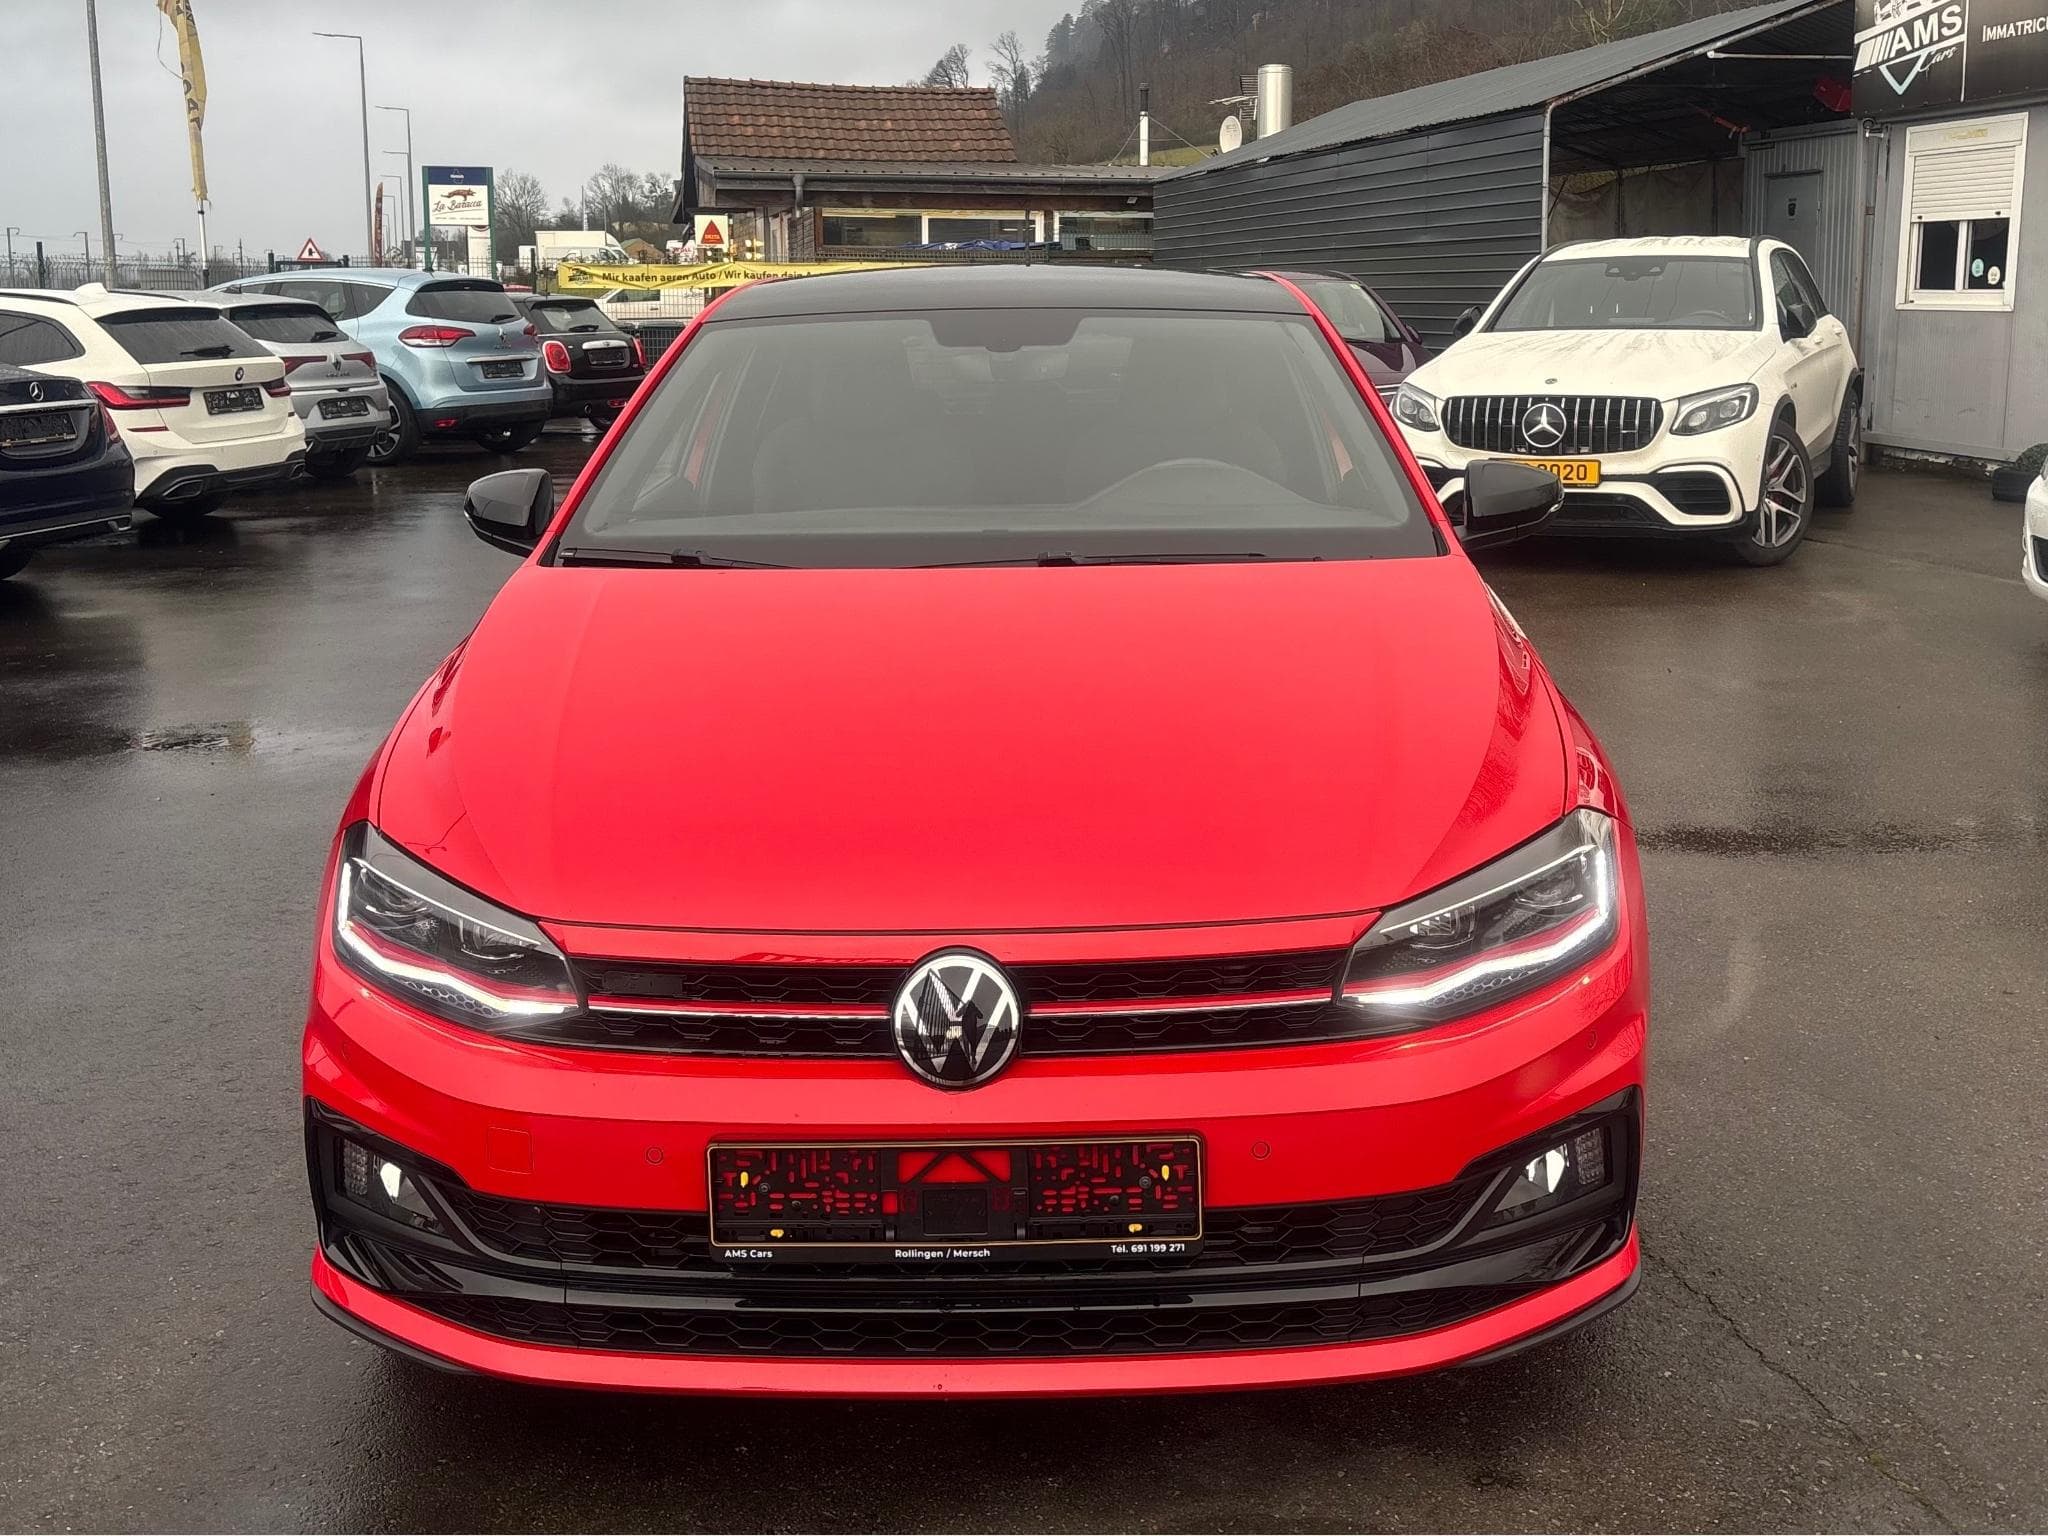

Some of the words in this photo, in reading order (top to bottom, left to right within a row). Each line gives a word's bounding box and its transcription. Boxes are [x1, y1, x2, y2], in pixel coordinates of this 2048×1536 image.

[1888, 4, 1963, 58] AMS
[1982, 17, 2048, 42] IMMATRIC
[1918, 46, 1958, 72] Cars
[432, 201, 445, 212] La
[602, 272, 620, 281] Mir
[622, 272, 658, 282] kaafen
[660, 274, 689, 282] aeren
[692, 271, 717, 280] Auto
[724, 270, 742, 279] Wir
[743, 270, 779, 280] kaufen
[724, 1249, 748, 1258] AMS
[749, 1249, 773, 1258] Cars
[894, 1248, 944, 1260] Rollingen
[945, 1247, 952, 1259] /
[953, 1248, 991, 1258] Mersch
[1130, 1243, 1148, 1253] 691
[1149, 1243, 1167, 1253] 199
[1168, 1243, 1185, 1252] 271
